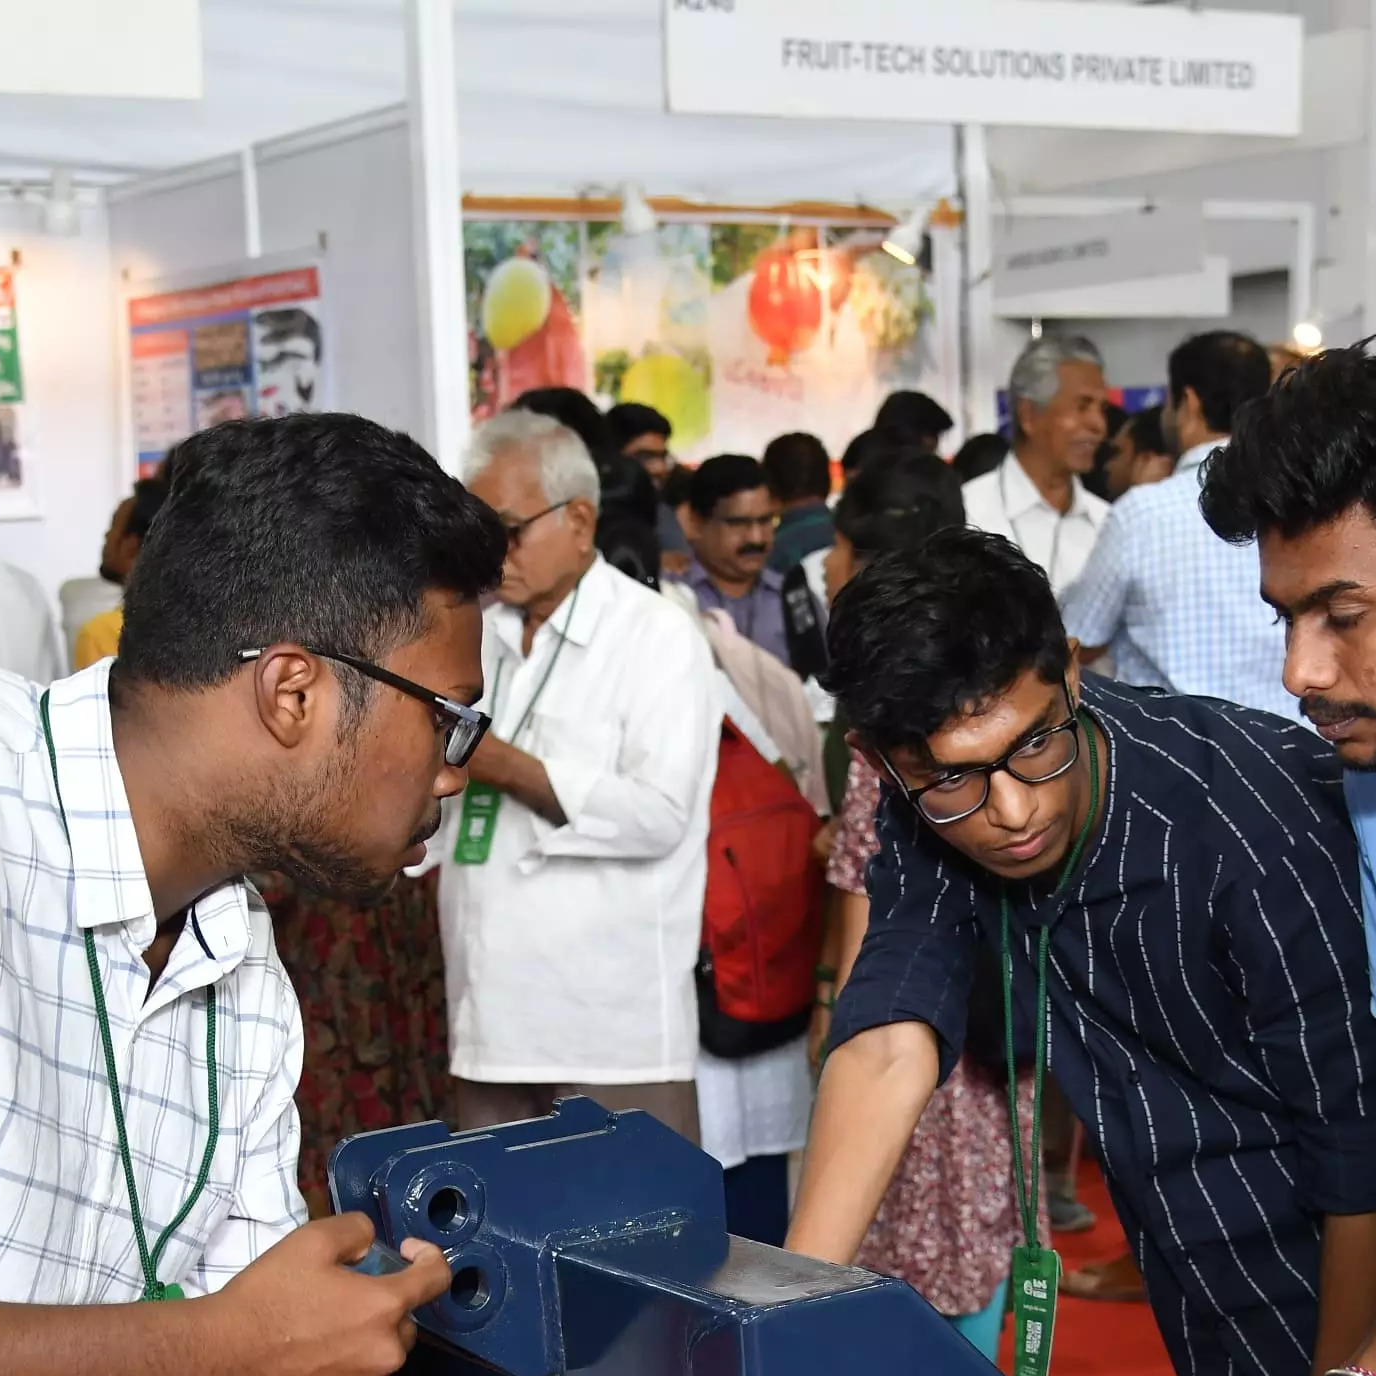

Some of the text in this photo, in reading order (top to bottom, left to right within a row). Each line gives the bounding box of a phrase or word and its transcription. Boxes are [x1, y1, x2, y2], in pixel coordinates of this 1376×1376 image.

[781, 37, 1257, 90] FRUIT-TECH SOLUTIONS PRIVATE LIMITED
